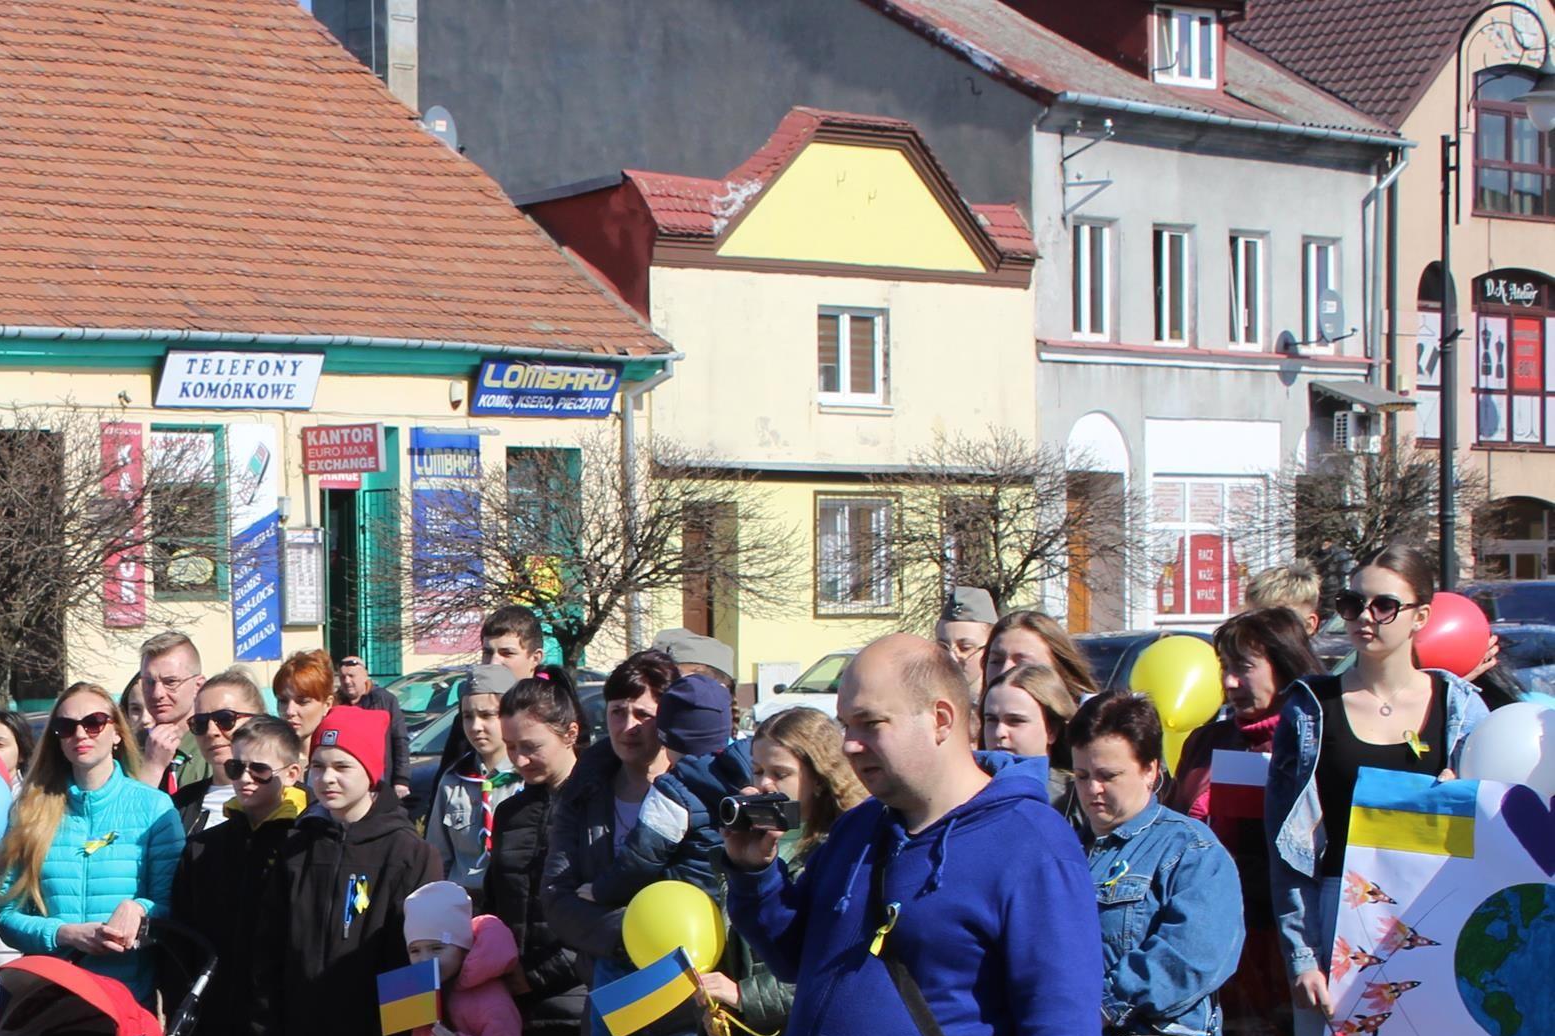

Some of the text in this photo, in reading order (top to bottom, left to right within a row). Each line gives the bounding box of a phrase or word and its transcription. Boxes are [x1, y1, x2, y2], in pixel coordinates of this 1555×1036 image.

[187, 358, 302, 376] TELEFONY
[483, 364, 616, 391] LOMBARD
[179, 378, 296, 400] KOMÓRKOWE
[477, 394, 610, 412] KOMIS, KSERO, PIECZĄTKI
[307, 427, 373, 445] KANTOR
[308, 445, 367, 458] EURO MAX
[308, 457, 376, 471] EXCHANGE
[236, 608, 267, 639] SERWIS
[236, 623, 276, 657] ZAMIANA
